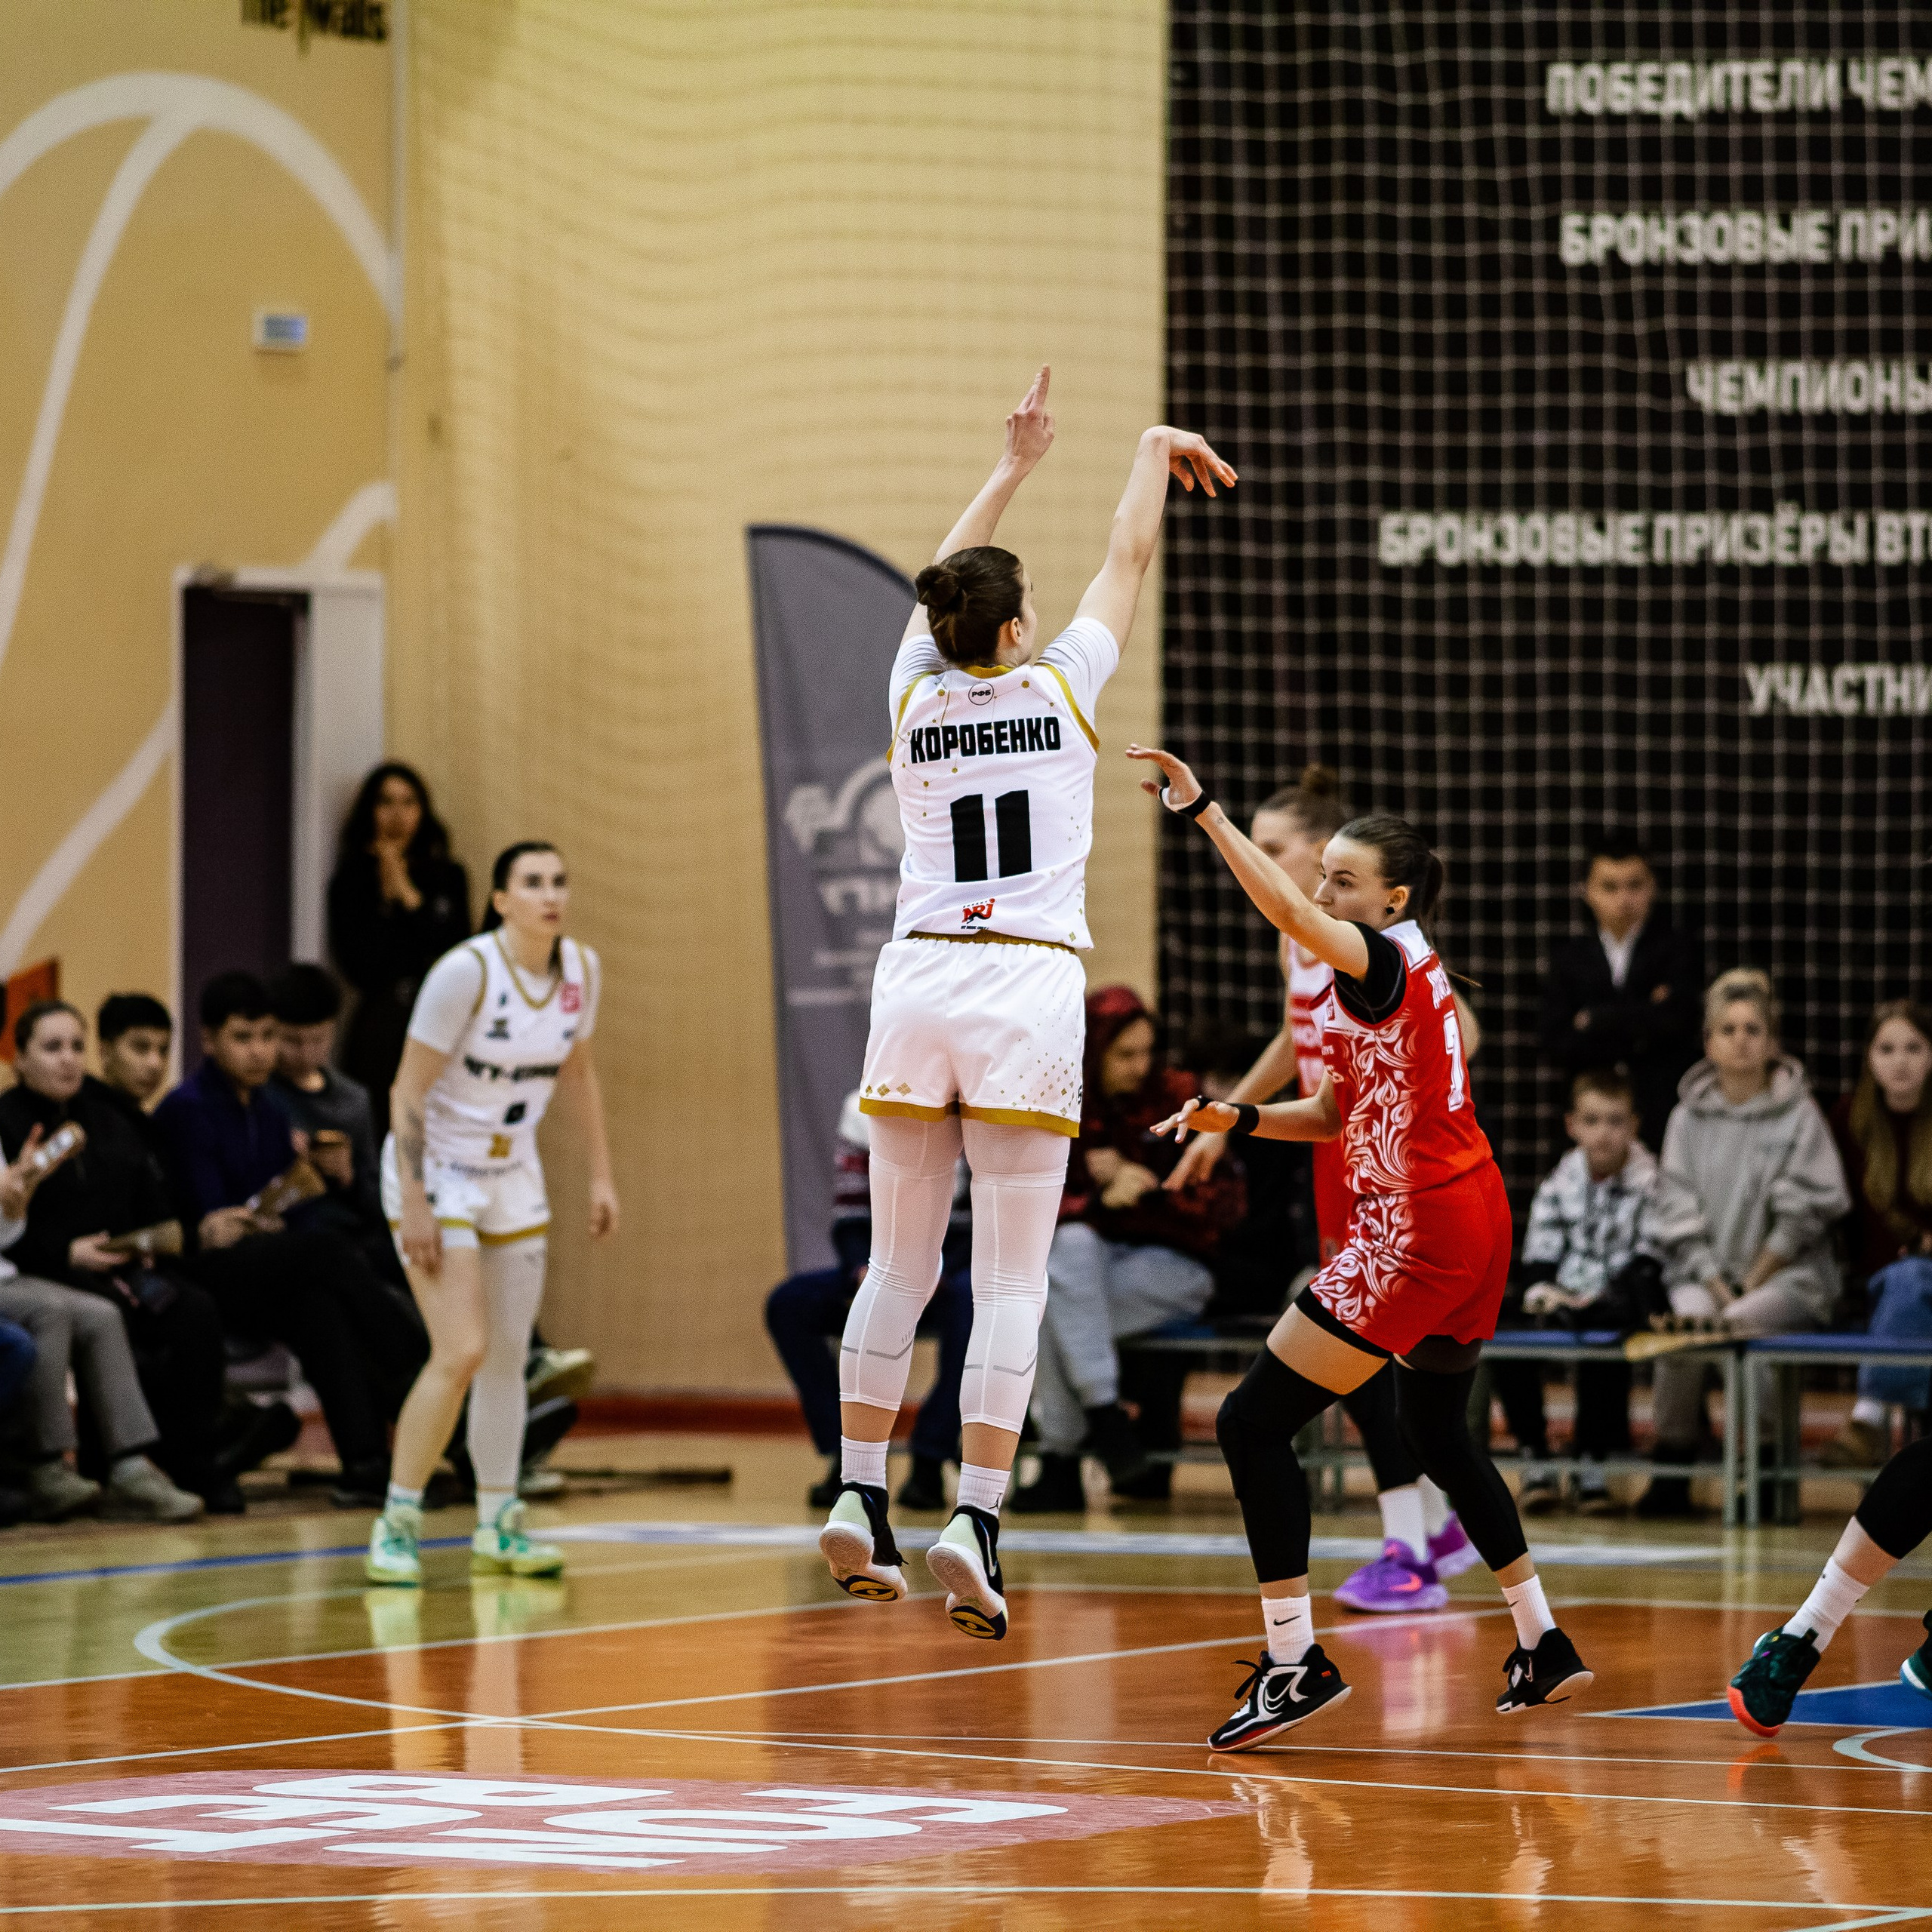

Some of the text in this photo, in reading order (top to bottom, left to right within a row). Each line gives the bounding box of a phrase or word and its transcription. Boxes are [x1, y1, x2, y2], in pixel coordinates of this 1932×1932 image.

[1546, 59, 1841, 121] ПОБЕДИТЕЛИ
[1559, 211, 1833, 266] БРОНЗОВЫЕ
[1378, 511, 1651, 567] БРОНЗОВЫЕ
[1653, 500, 1869, 566] ПРИЗЁРЫ
[971, 689, 992, 698] РФБ
[910, 716, 1061, 764] КОРОБЕНКО
[949, 789, 1032, 883] 11
[0, 1775, 675, 1854] BET
[323, 1789, 1069, 1868] FON
